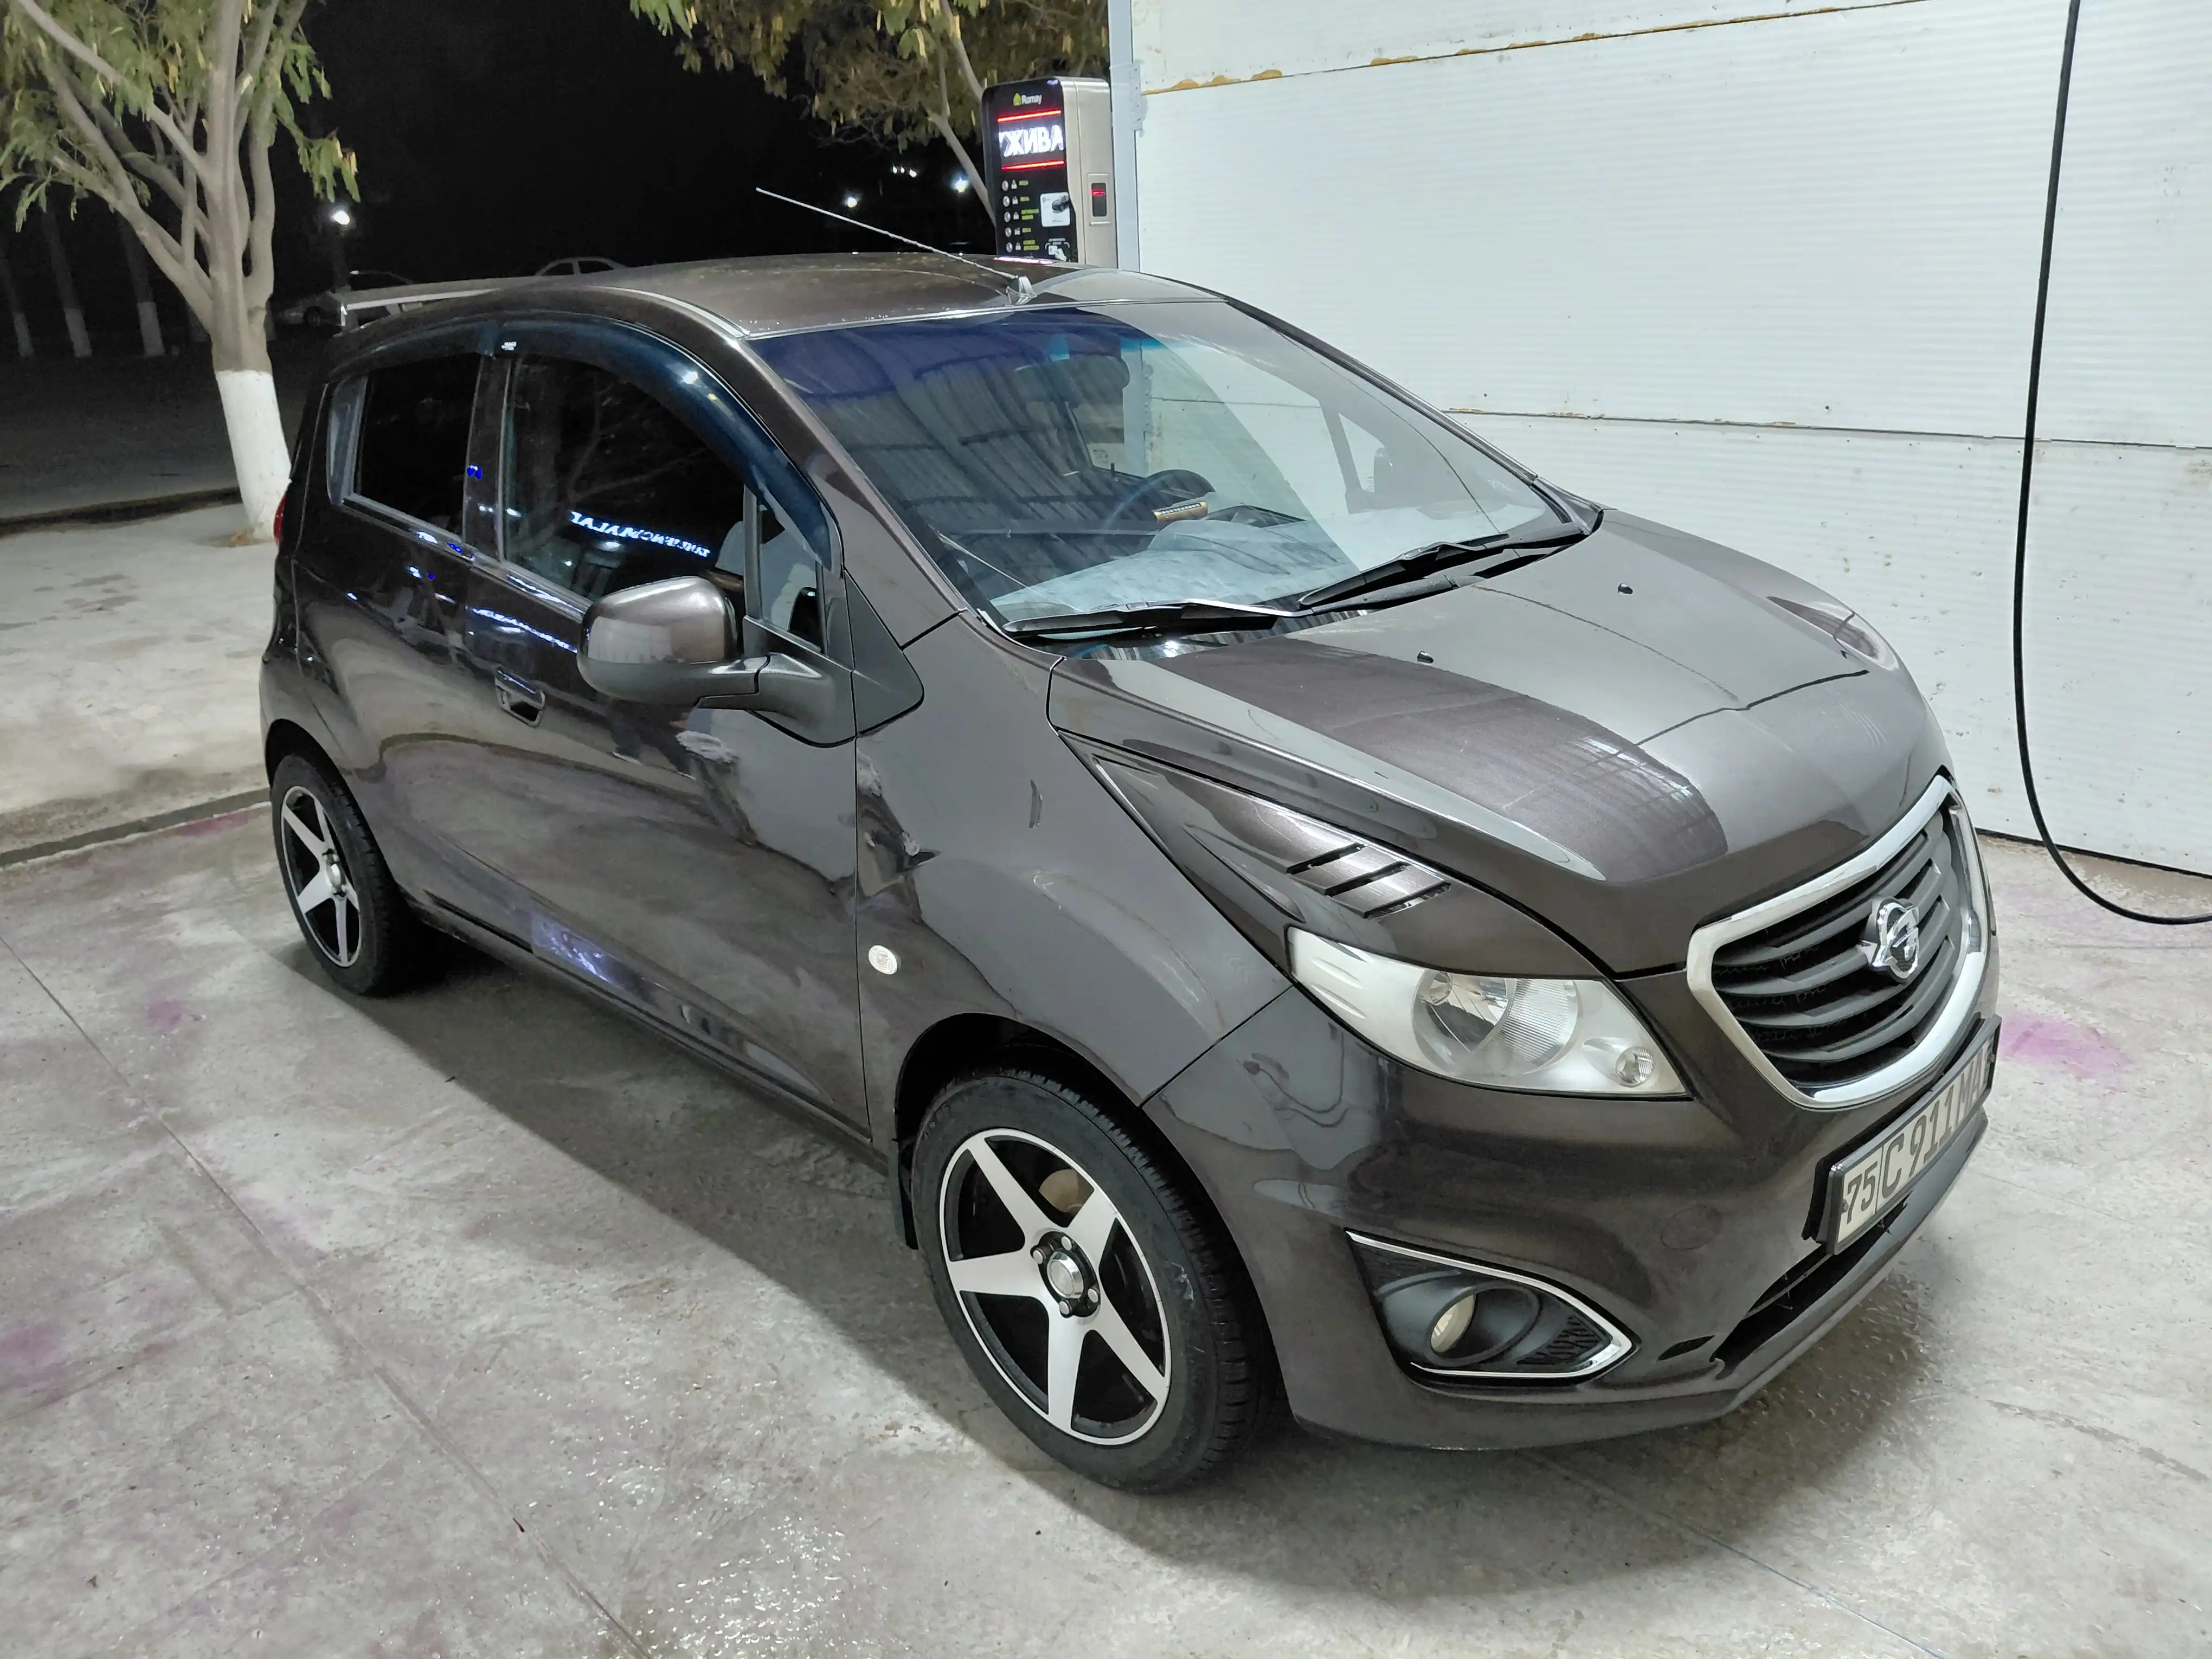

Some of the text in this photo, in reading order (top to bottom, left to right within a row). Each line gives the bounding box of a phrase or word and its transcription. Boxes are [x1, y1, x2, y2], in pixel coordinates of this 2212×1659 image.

[1847, 1161, 1877, 1224] 75
[1881, 1132, 1905, 1199] C
[1908, 1084, 1954, 1178] 911
